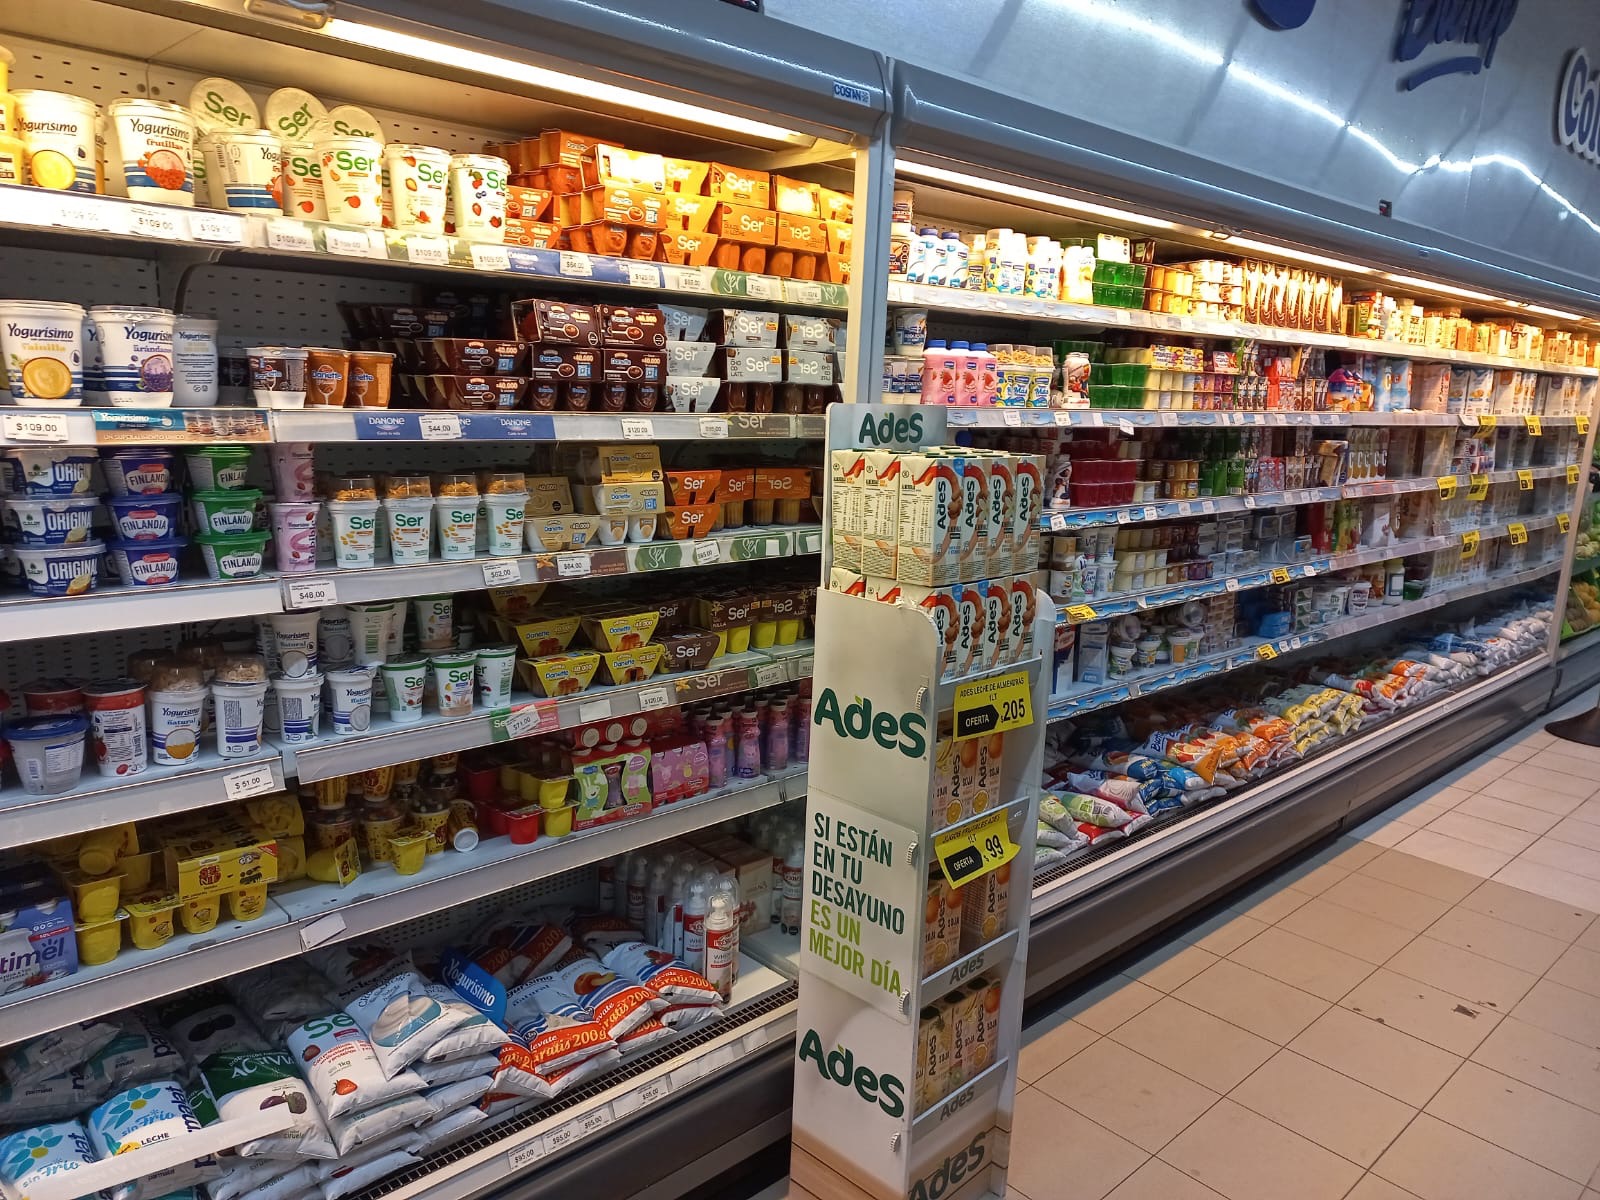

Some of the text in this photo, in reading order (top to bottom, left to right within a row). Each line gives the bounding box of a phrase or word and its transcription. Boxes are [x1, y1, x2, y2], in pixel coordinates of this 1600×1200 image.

[204, 91, 251, 126] Ser
[278, 102, 313, 137] Ser
[292, 157, 321, 177] Se
[336, 150, 374, 172] Ser
[487, 170, 506, 190] Se
[726, 173, 755, 192] Ser
[740, 215, 764, 232] Ser
[677, 235, 701, 251] Ser
[672, 311, 692, 326] Ser
[738, 317, 764, 334] Ser
[674, 347, 698, 361] Ser
[745, 358, 769, 373] Ser
[681, 382, 703, 396] Ser
[16, 422, 58, 433] $109.00
[368, 417, 405, 426] DANONE
[500, 418, 532, 427] DANONE
[738, 415, 766, 429] Ser
[684, 477, 705, 490] Ser
[728, 478, 746, 492] Ser
[395, 513, 423, 528] Ser
[451, 510, 476, 524] Ser
[506, 508, 523, 520] Se
[681, 511, 704, 524] Ser
[350, 516, 374, 530] Ser
[134, 561, 177, 576] FINLANDIA
[299, 591, 325, 599] $48.00
[433, 603, 452, 615] Se
[659, 605, 678, 617] Ser
[728, 606, 749, 620] Ser
[676, 645, 701, 658] Ser
[449, 671, 472, 682] Ser
[696, 674, 723, 690] Ser
[493, 718, 506, 728] Se
[965, 714, 990, 727] OFERTA
[814, 812, 892, 867] SI ESTÁN
[813, 841, 862, 884] EN TU
[953, 856, 974, 871] OFERTA
[812, 870, 905, 935] DESAYUNO
[811, 899, 861, 946] ES UN
[809, 927, 902, 997] MEJOR DÍA
[596, 1001, 615, 1024] evate
[303, 1013, 355, 1040] Se
[141, 1133, 170, 1145] LECHE
